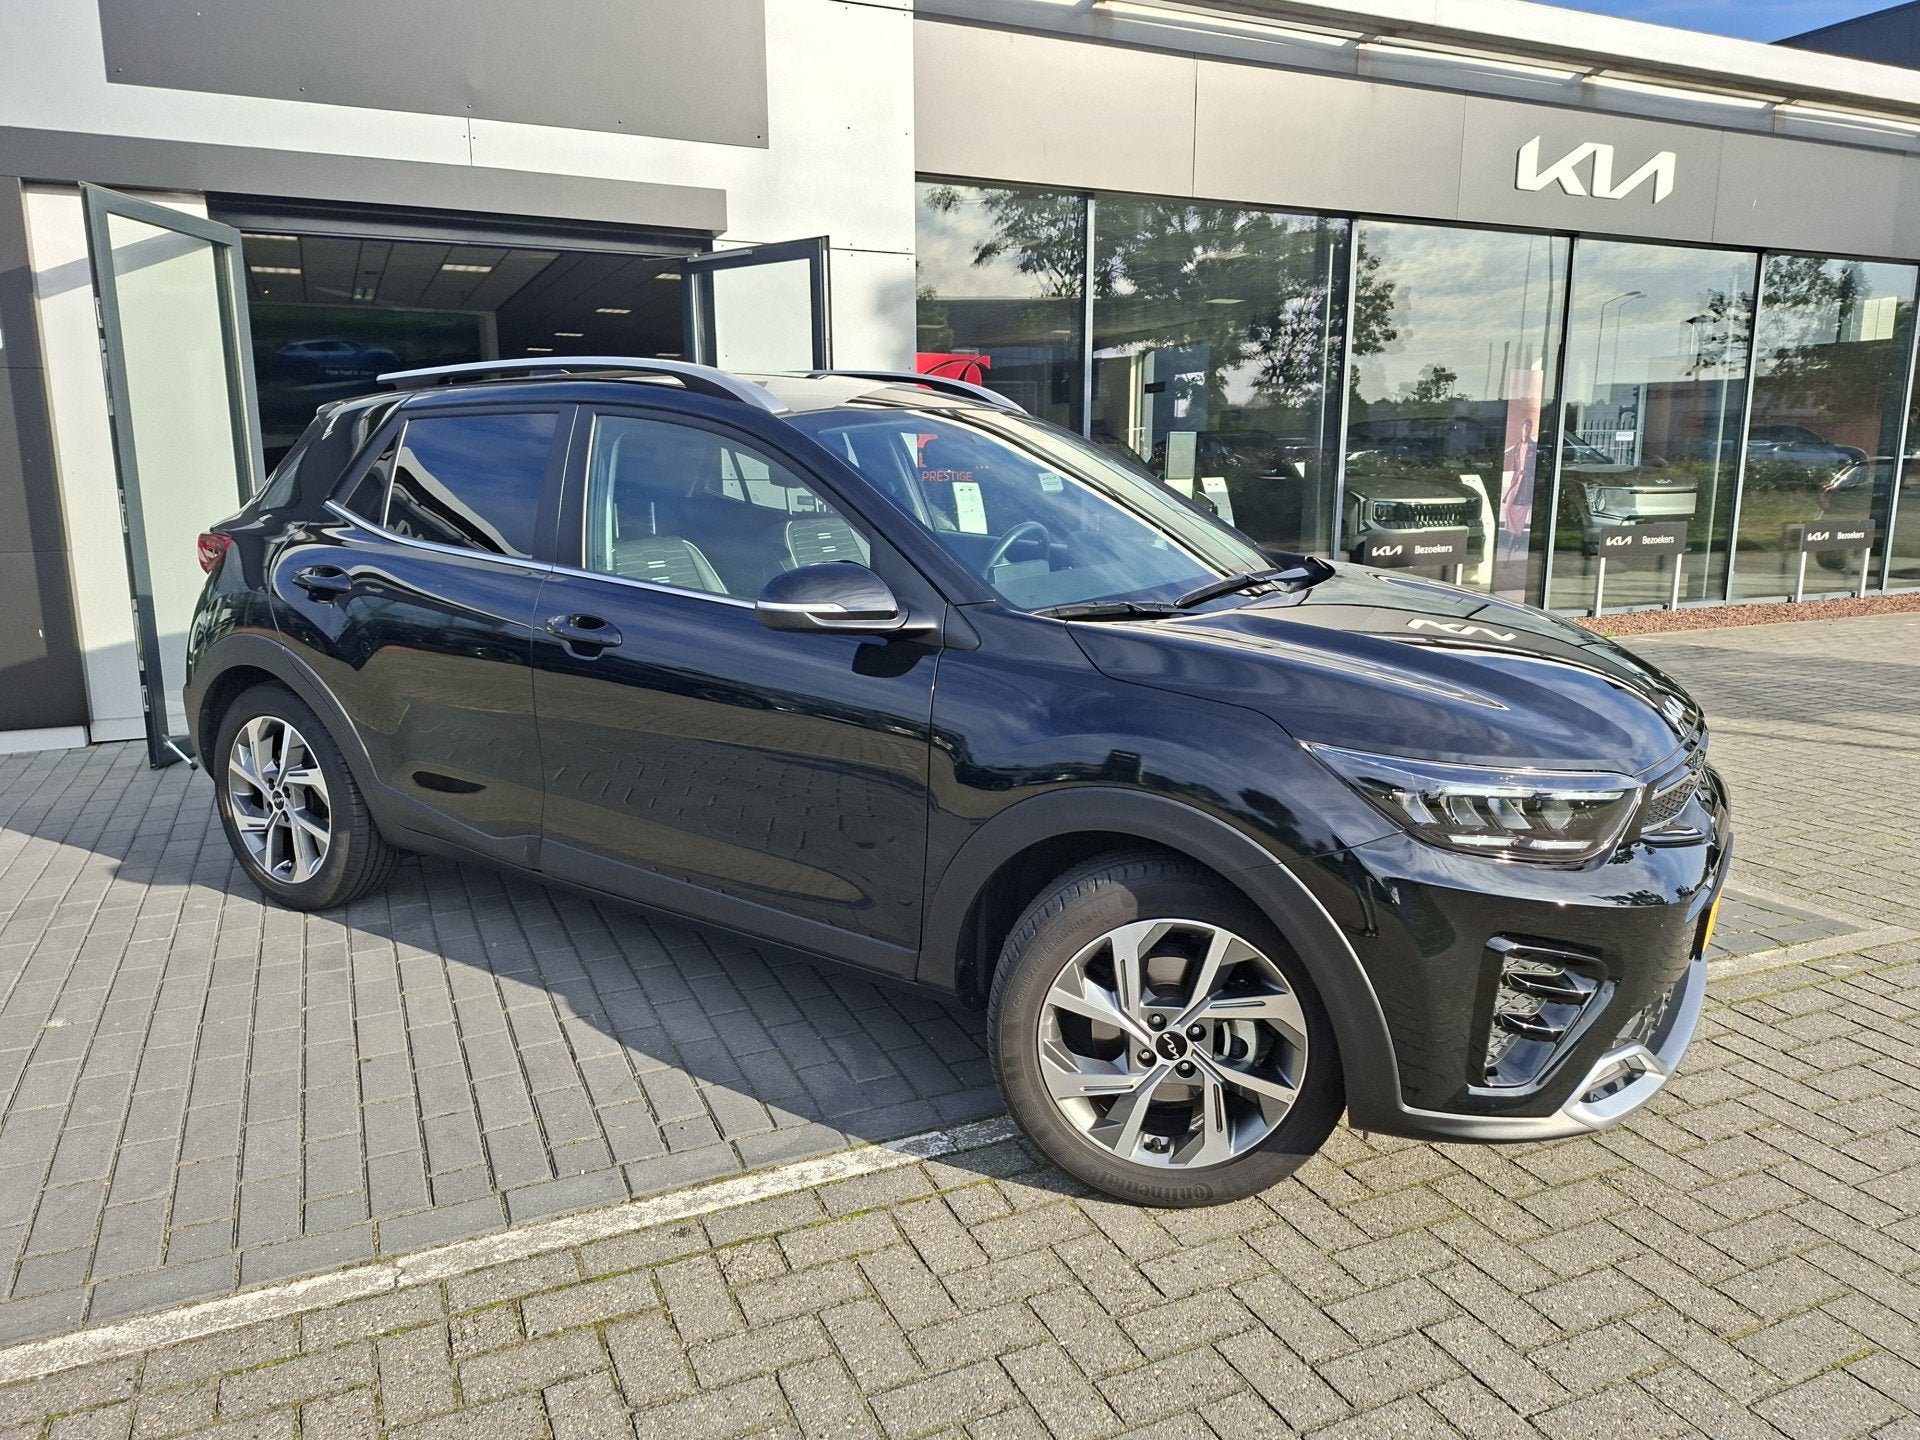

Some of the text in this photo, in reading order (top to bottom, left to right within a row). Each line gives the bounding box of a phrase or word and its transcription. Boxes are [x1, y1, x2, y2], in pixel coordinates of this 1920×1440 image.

[1515, 135, 1677, 204] KIA
[922, 470, 973, 482] PRESTIGE
[1605, 534, 1675, 546] KIA Bezoekers
[1807, 530, 1865, 541] KIA Bezoekers
[1371, 543, 1453, 557] KIA Bezoekers
